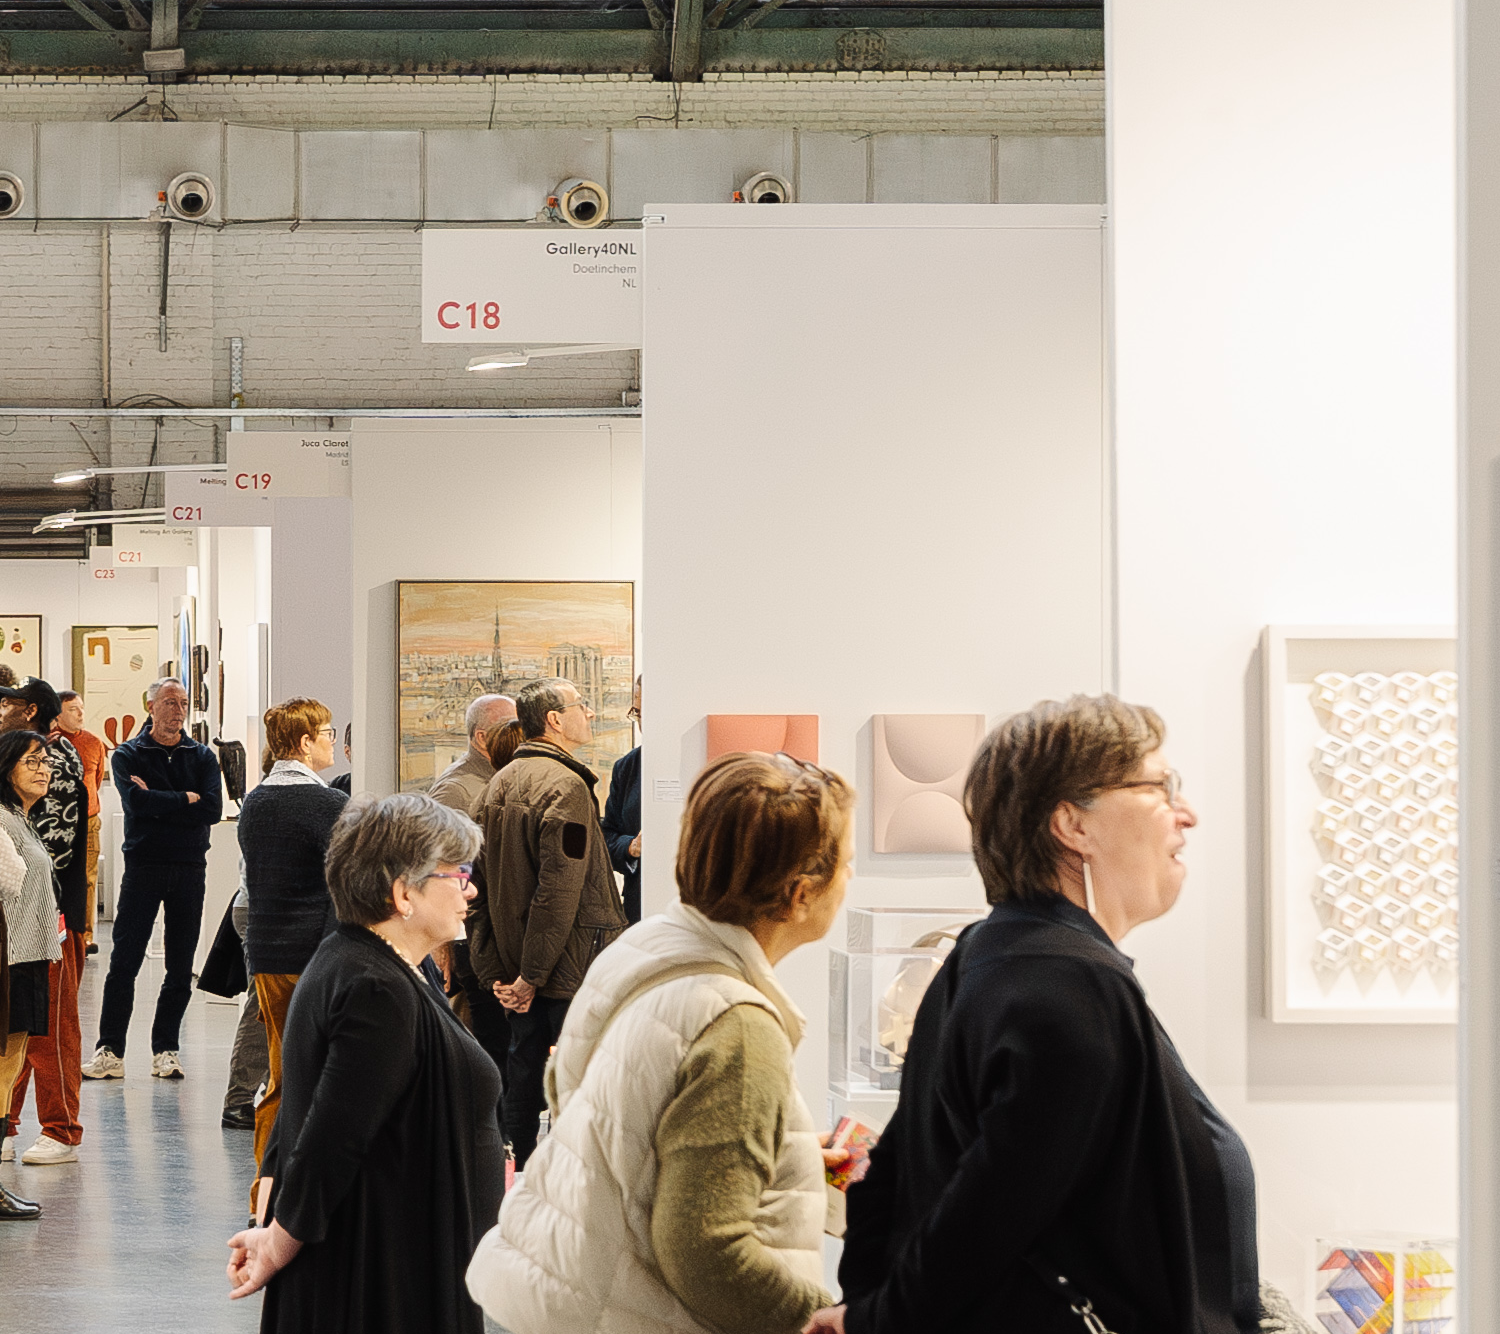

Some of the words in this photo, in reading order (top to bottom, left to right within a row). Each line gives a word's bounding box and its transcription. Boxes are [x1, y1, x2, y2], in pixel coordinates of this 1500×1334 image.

[545, 242, 637, 258] Gallery40NL
[572, 263, 637, 274] Doetinchem
[621, 278, 637, 288] NL
[437, 301, 501, 330] C18
[235, 473, 272, 490] C19
[172, 506, 202, 521] C21
[118, 551, 142, 563] C21
[94, 569, 116, 579] C23
